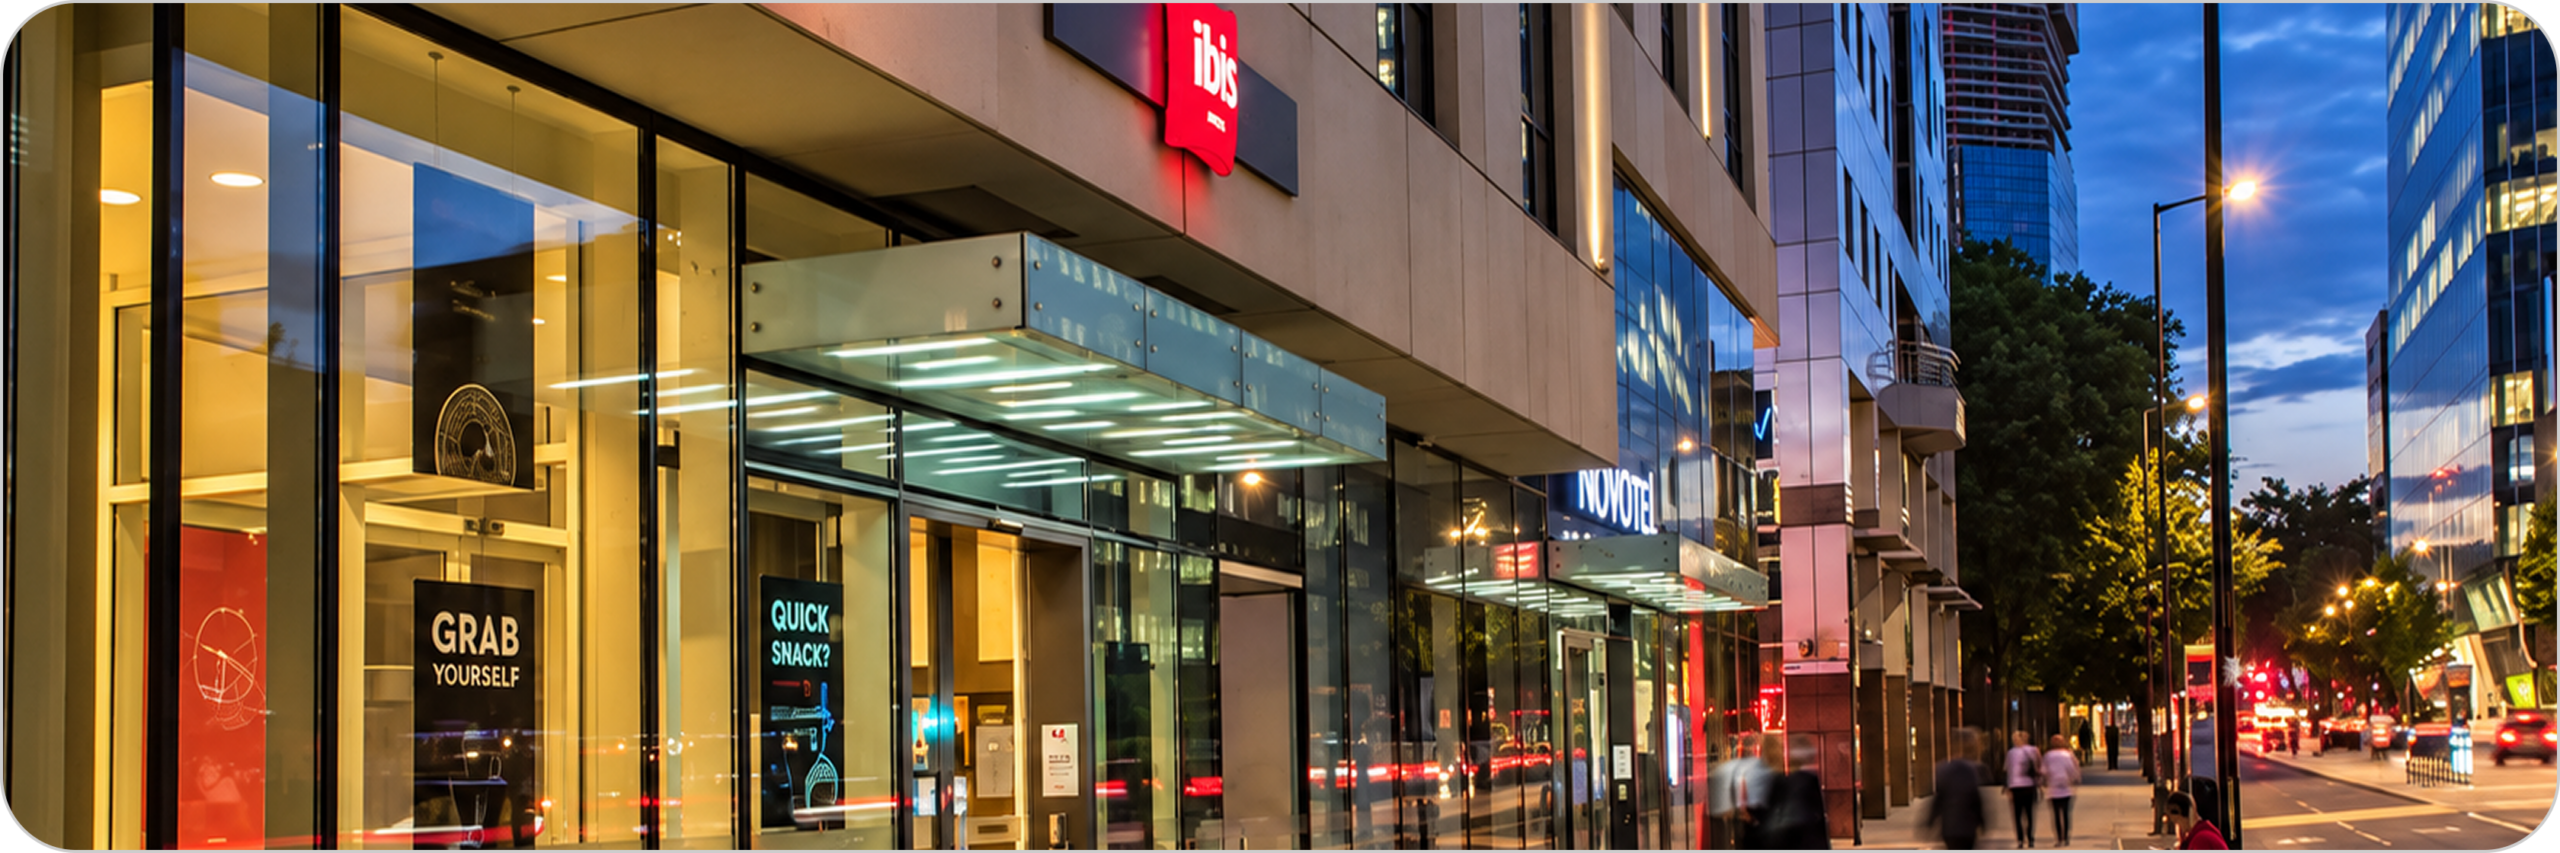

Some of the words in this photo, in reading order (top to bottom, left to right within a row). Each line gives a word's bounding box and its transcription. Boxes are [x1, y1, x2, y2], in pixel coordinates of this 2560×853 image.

[1193, 19, 1238, 109] ibis
[1578, 468, 1659, 535] NOVOTEL
[431, 610, 520, 656] GRAB
[771, 600, 829, 633] QUICK
[771, 640, 831, 667] SNACK?
[432, 663, 520, 688] YOURSELF
